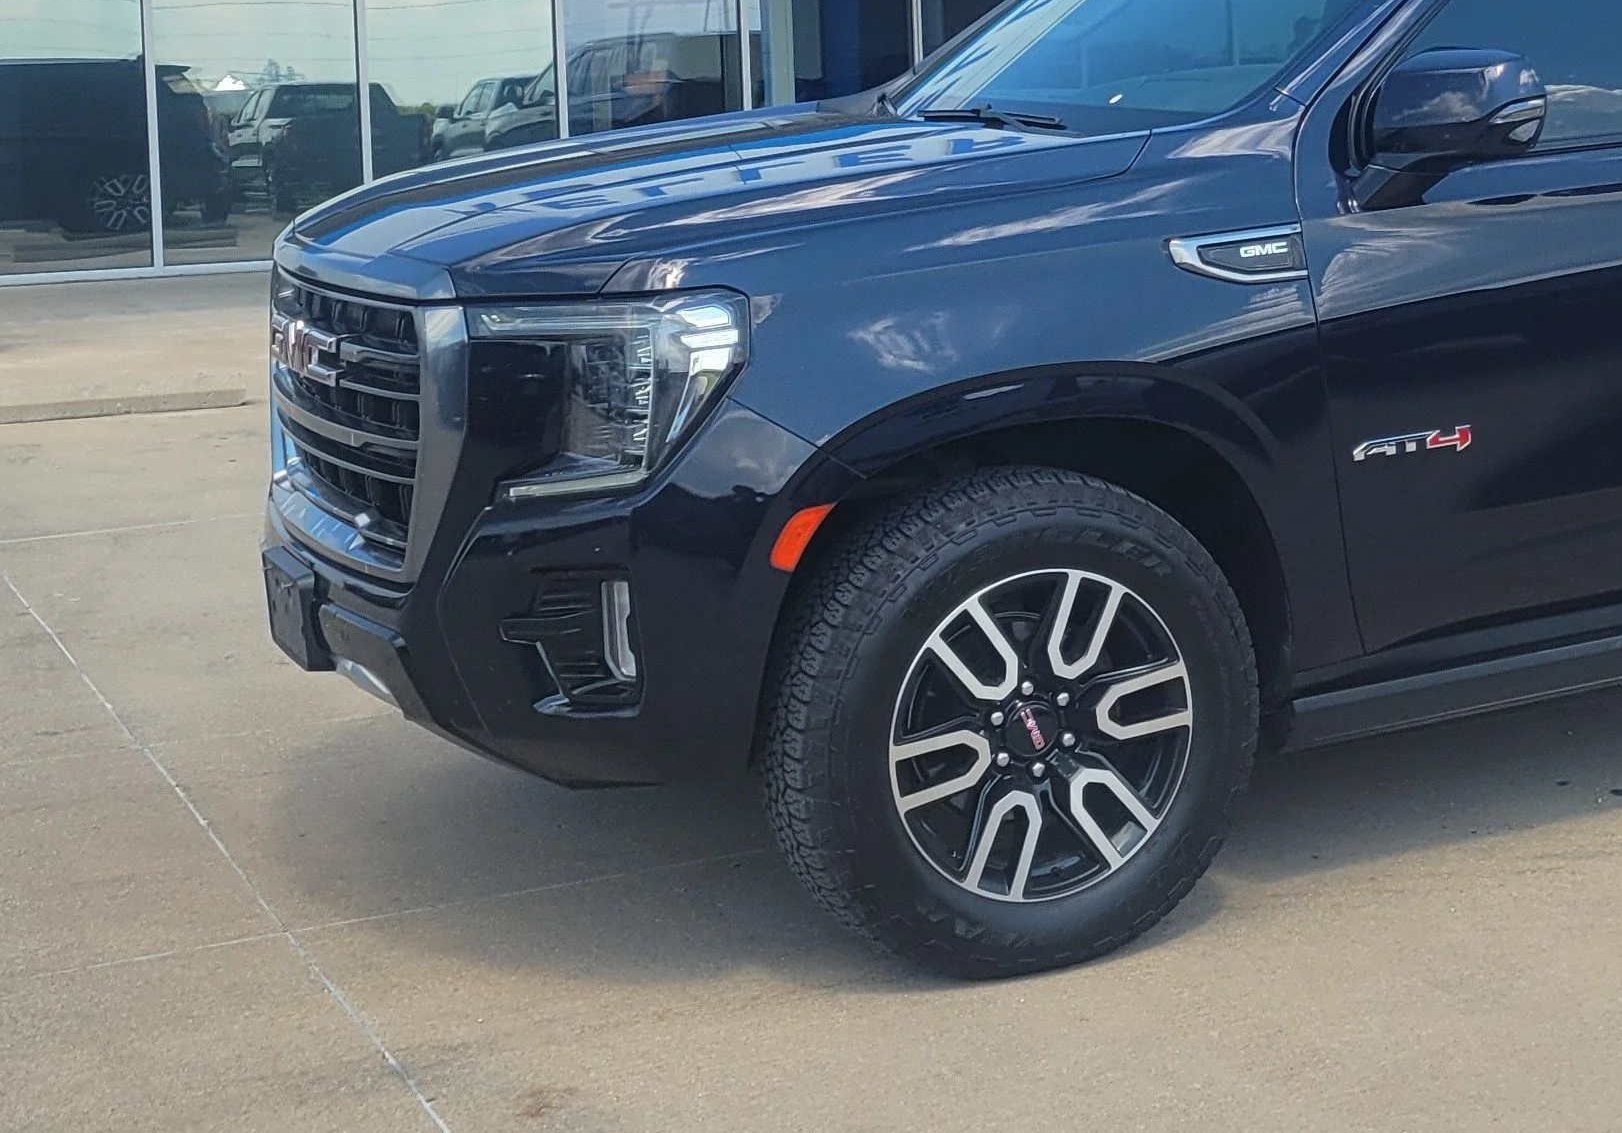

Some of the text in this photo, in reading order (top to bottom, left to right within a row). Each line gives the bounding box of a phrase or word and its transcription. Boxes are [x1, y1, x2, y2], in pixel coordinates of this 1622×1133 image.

[1239, 241, 1288, 258] GMC
[1352, 424, 1472, 462] AT4
[1020, 708, 1046, 751] GMC
